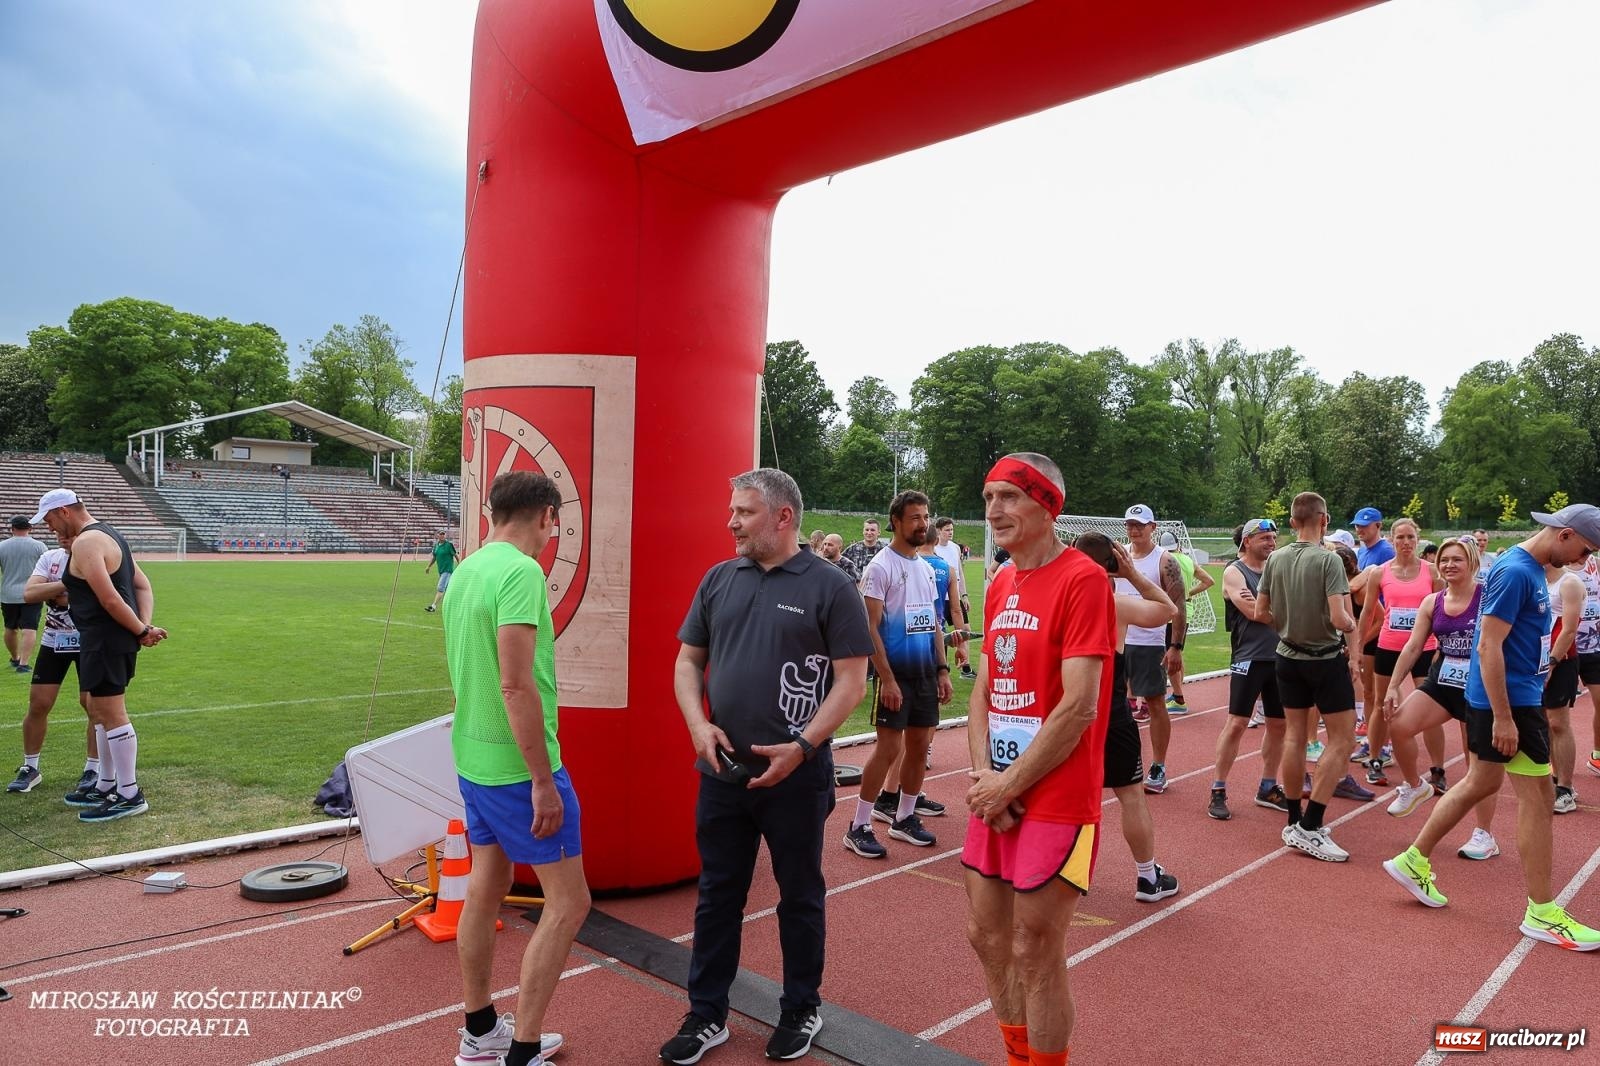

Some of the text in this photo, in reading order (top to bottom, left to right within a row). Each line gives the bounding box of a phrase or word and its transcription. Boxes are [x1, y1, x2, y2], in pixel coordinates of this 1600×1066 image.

[1005, 594, 1020, 609] OD
[913, 614, 930, 626] 205
[1398, 617, 1416, 626] 216
[65, 636, 80, 646] 19
[1010, 717, 1036, 725] GRANIC
[992, 738, 1020, 761] 168
